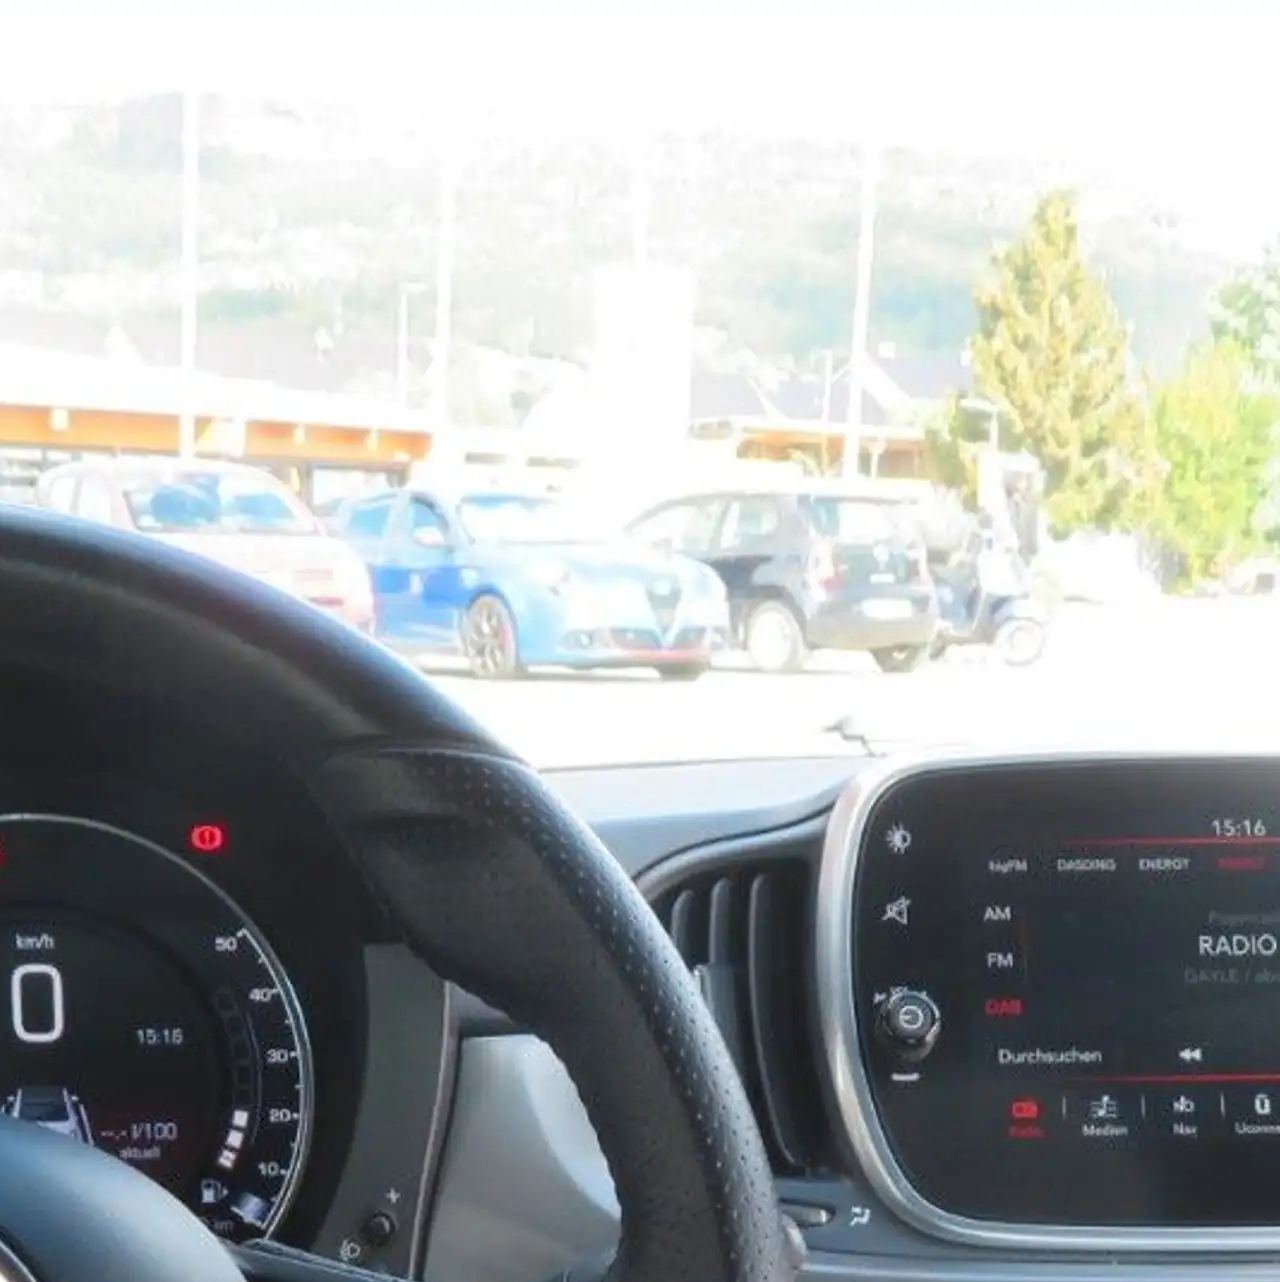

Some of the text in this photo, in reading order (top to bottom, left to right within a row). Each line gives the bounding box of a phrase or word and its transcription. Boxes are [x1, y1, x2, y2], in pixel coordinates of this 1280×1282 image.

[1211, 820, 1266, 836] 15:16
[983, 906, 1011, 922] AM
[16, 933, 54, 949] km/h
[214, 935, 237, 951] 50
[1199, 933, 1277, 956] RADIO
[987, 953, 1014, 969] FM
[11, 963, 64, 1042] 0
[248, 987, 272, 1003] 40
[267, 1049, 289, 1063] 30
[997, 1048, 1103, 1064] Durchsuchen
[270, 1108, 291, 1122] 20
[1082, 1124, 1129, 1137] Medien
[257, 1161, 279, 1176] 10
